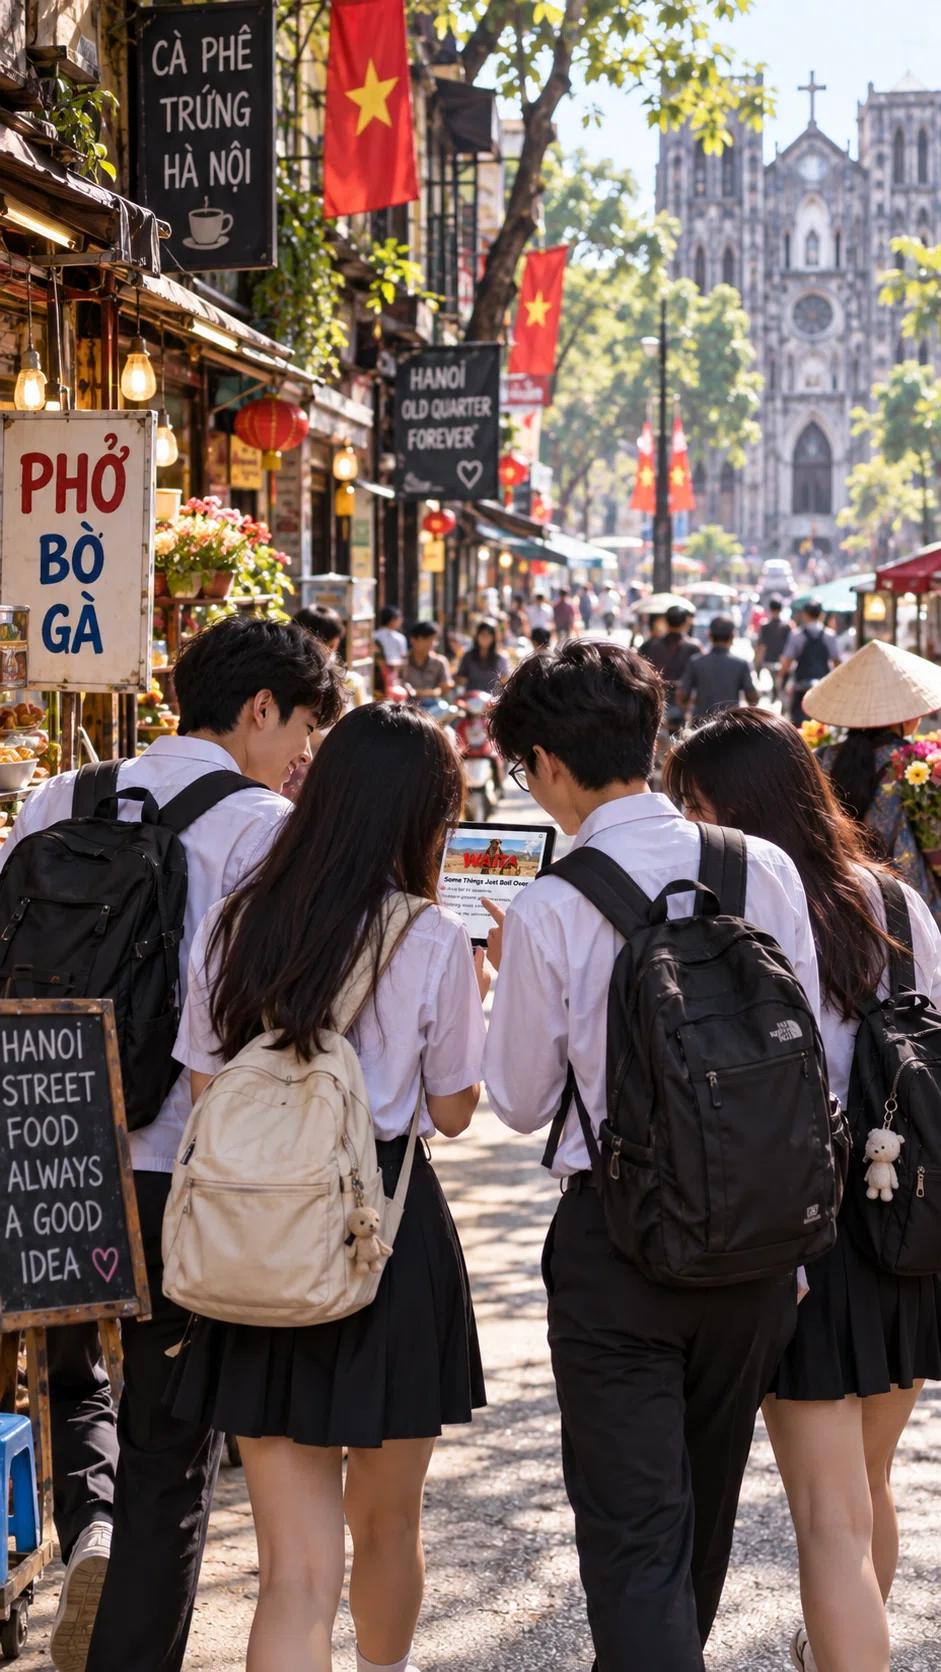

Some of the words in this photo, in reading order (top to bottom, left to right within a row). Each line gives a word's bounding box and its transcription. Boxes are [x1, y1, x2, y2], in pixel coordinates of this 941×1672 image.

[152, 29, 188, 76] CÀ
[201, 24, 253, 73] PHÊ
[159, 84, 251, 133] TRỨNG
[164, 143, 199, 190] HÀ
[209, 140, 251, 193] NỘI
[401, 399, 428, 420] OLD
[431, 396, 492, 421] QUARTER
[20, 433, 130, 514] PHỞ
[41, 590, 104, 655] GÀ
[463, 877, 484, 886] Things
[2, 1071, 96, 1106] STREET
[7, 1115, 79, 1149] FOOD
[7, 1155, 104, 1193] ALWAYS
[5, 1205, 23, 1239] A
[33, 1200, 103, 1236] GOOD
[21, 1247, 81, 1284] IDEA
